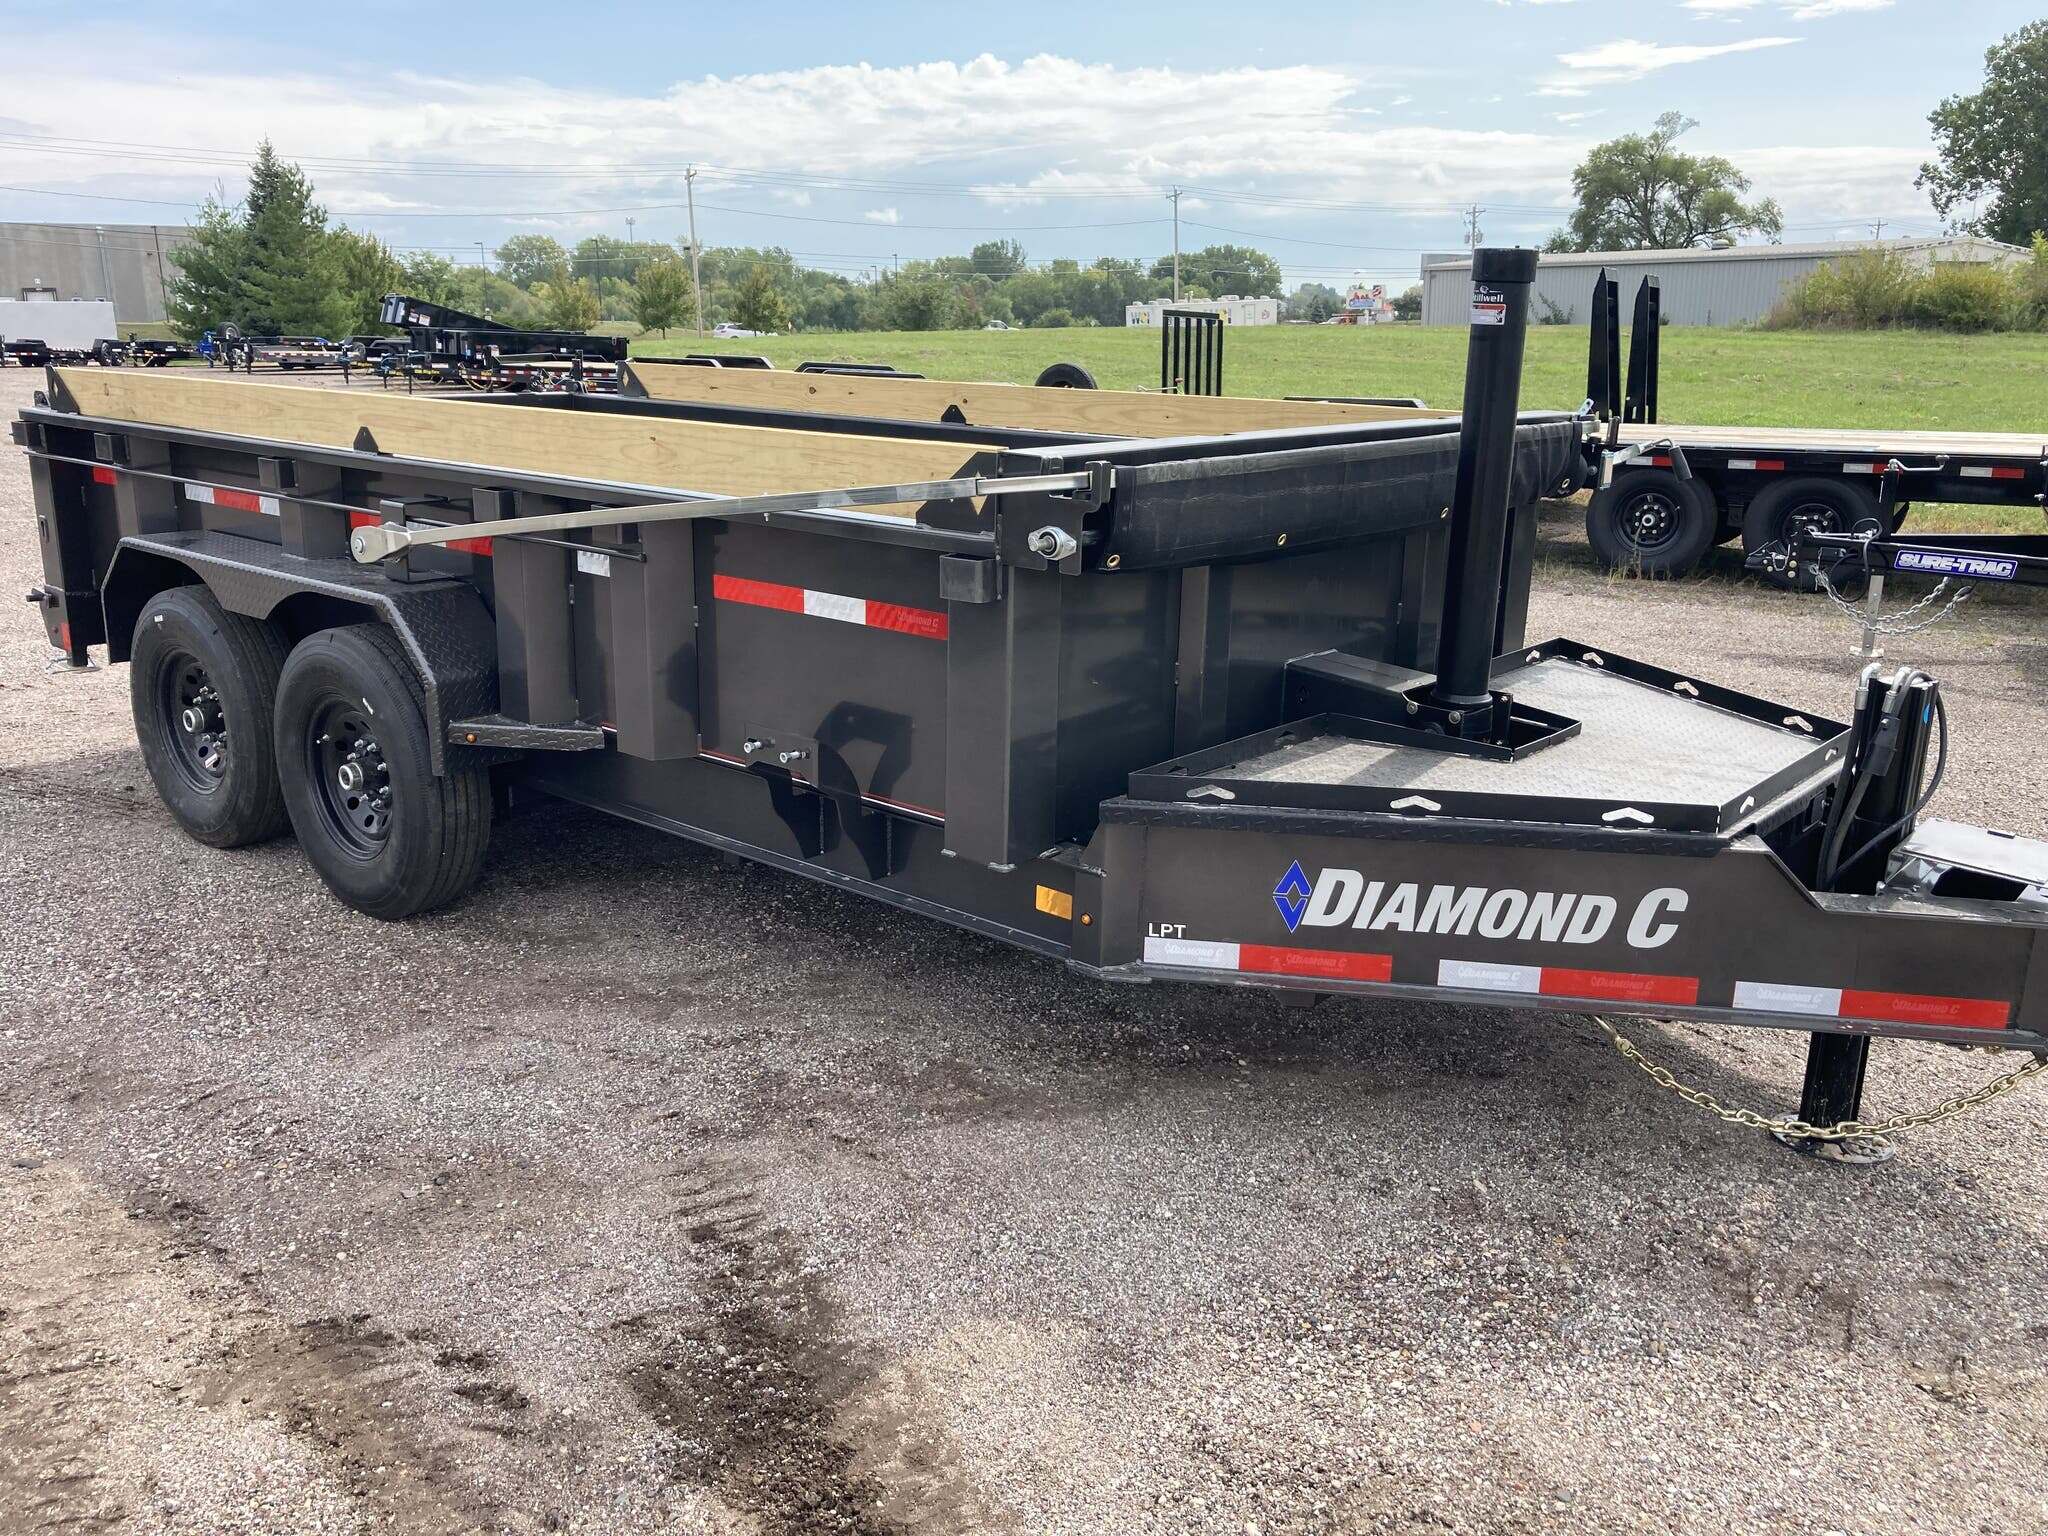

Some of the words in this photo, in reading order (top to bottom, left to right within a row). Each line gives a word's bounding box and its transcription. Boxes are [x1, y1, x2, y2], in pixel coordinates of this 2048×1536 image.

[1898, 553, 2013, 577] SURE-TRAC
[1303, 868, 1617, 944] DIAMOND
[1627, 887, 1689, 948] C
[1148, 922, 1187, 938] LPT
